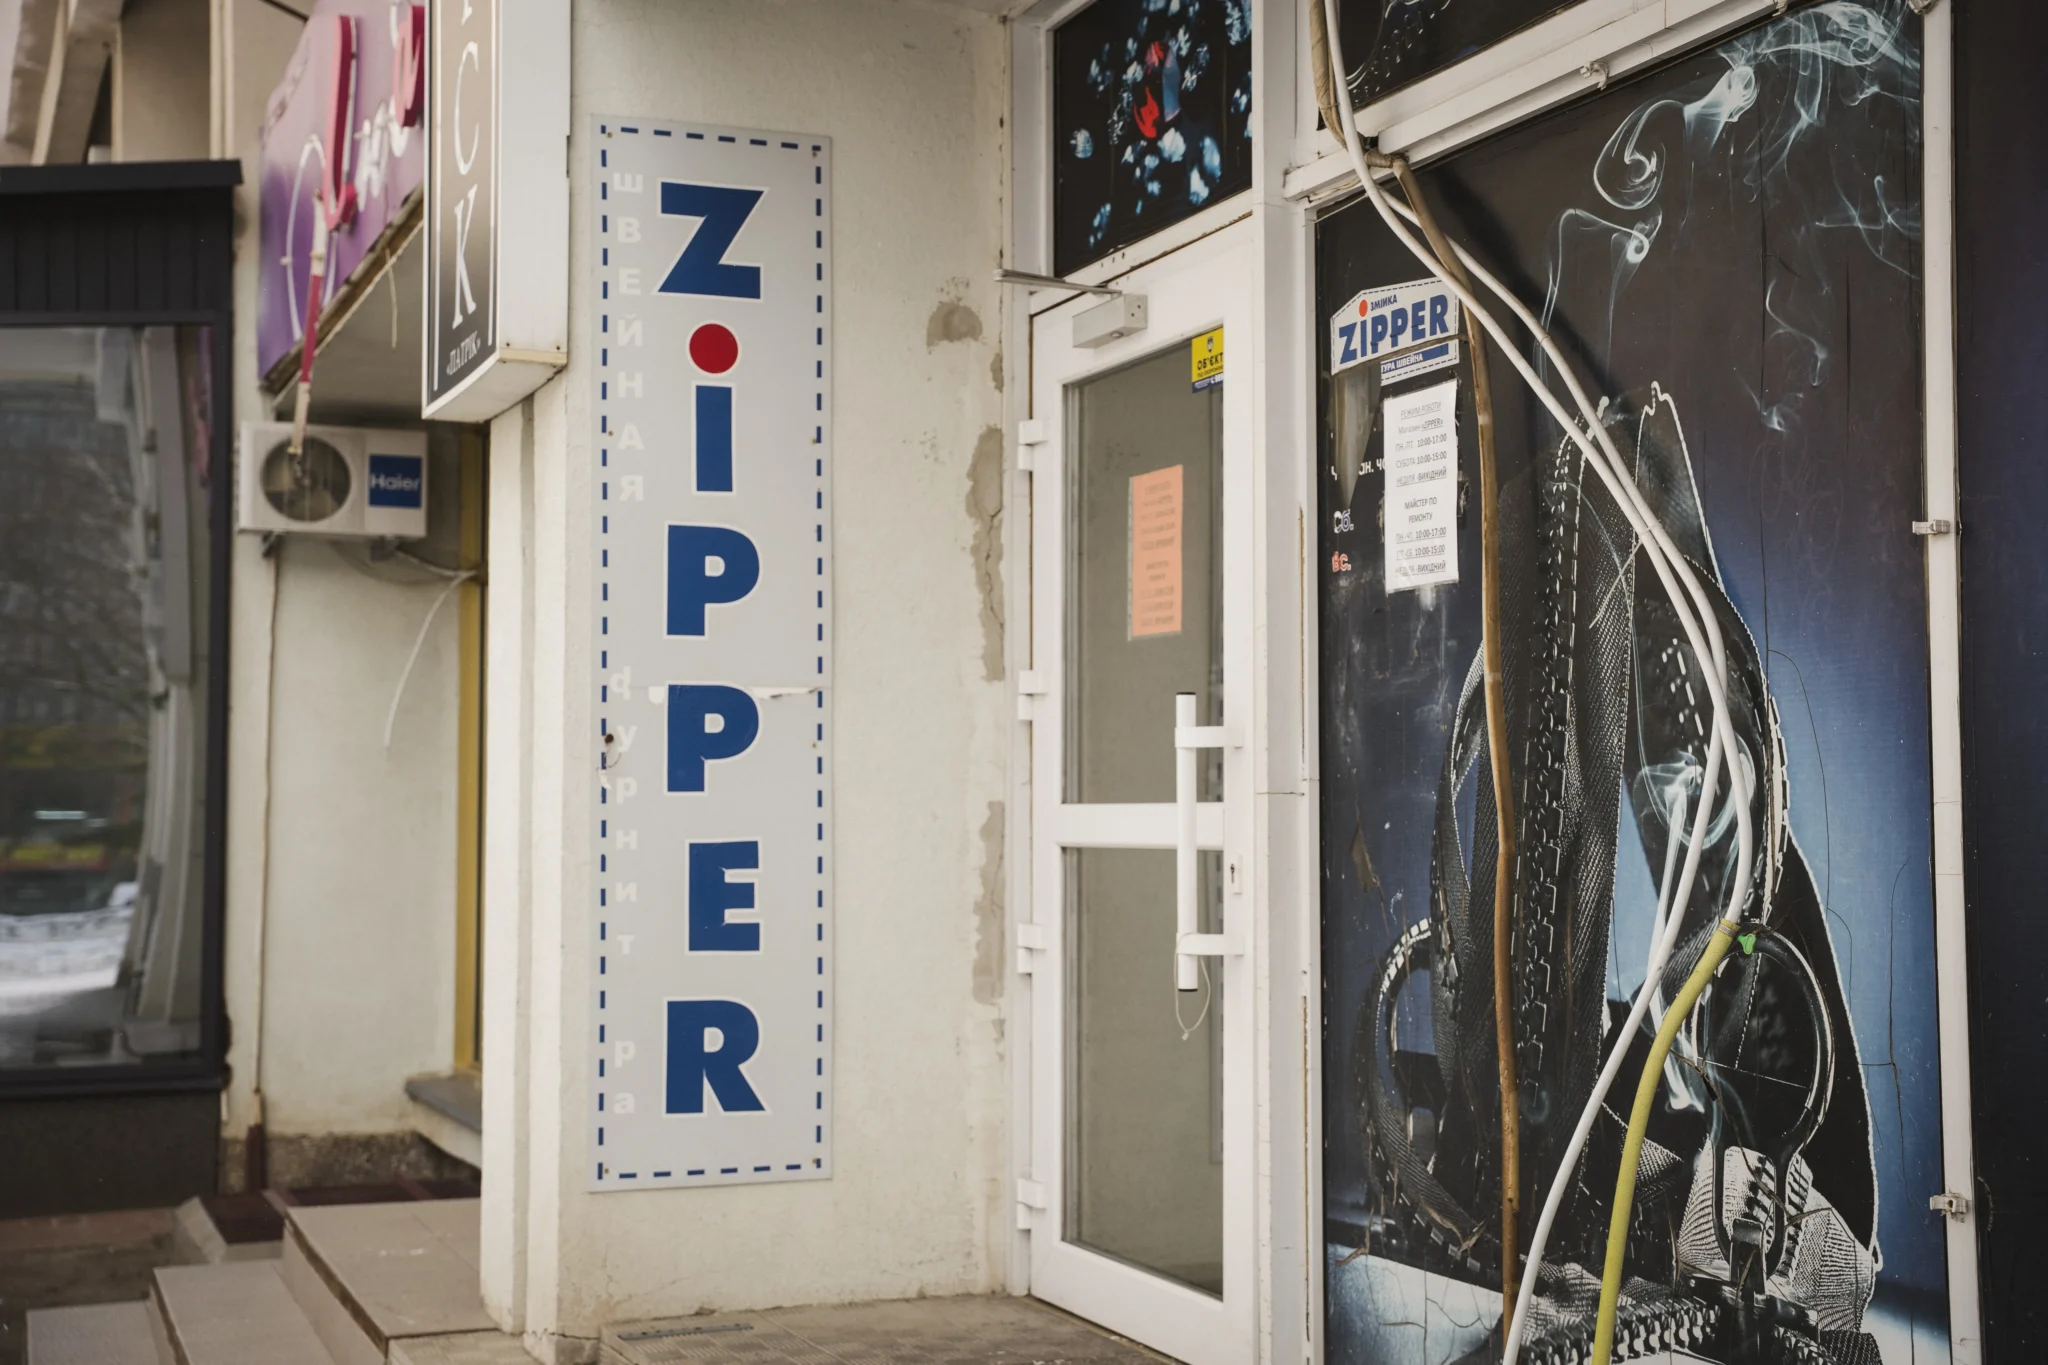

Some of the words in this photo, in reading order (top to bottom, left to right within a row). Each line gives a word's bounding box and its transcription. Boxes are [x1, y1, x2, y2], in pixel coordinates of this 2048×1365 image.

[453, 0, 479, 329] CK
[1339, 294, 1449, 365] ZIPPER
[1417, 433, 1447, 448] 10:00-17:00
[1417, 450, 1447, 465] 10:00-15:00
[370, 473, 421, 492] Haier
[1429, 496, 1437, 506] ПО
[1408, 512, 1433, 524] РЕМОНТУ
[1415, 527, 1446, 539] 10:00-17:00
[1415, 544, 1446, 557] 10:00-15:00
[655, 180, 767, 1115] ZIPPER
